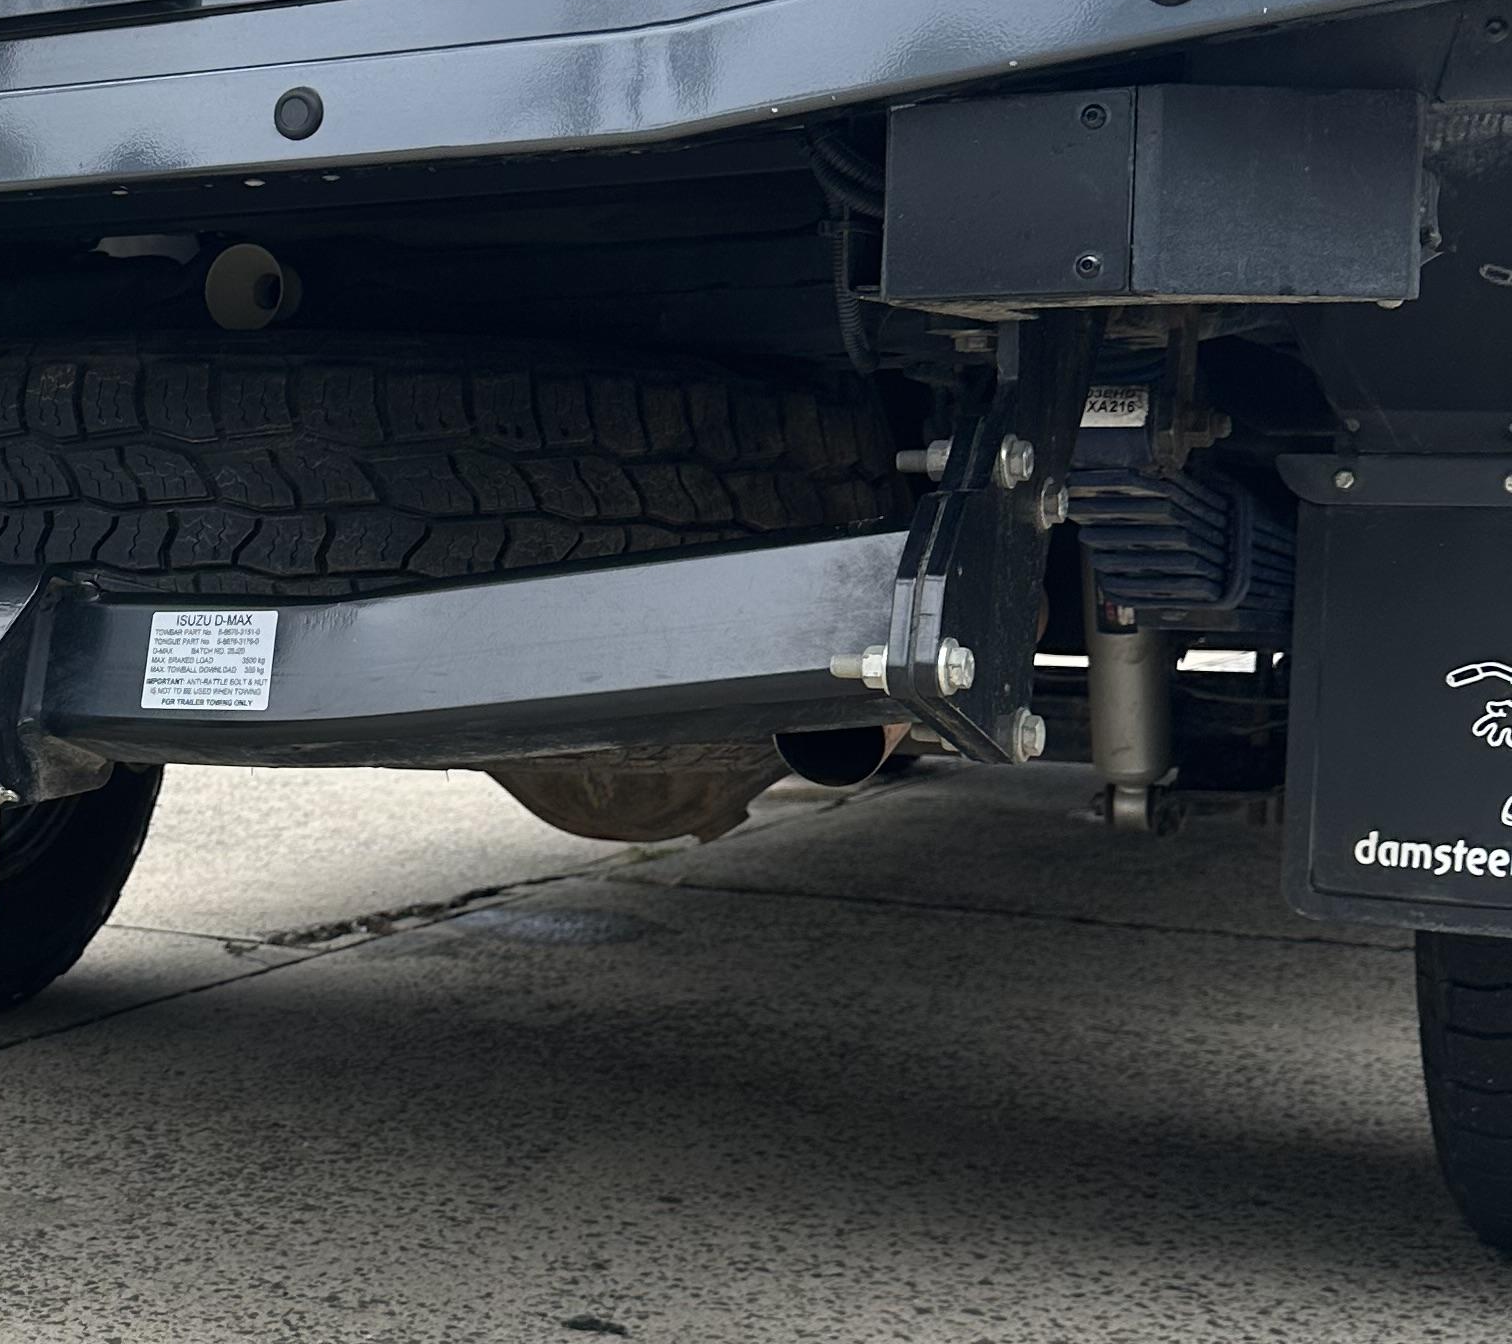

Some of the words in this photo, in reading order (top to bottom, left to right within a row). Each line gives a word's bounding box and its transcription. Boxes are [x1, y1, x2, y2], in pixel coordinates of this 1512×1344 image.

[1087, 400, 1135, 412] XA216
[176, 615, 212, 626] ISUZU
[215, 614, 253, 626] D-MAX
[1354, 830, 1512, 878] damstee
